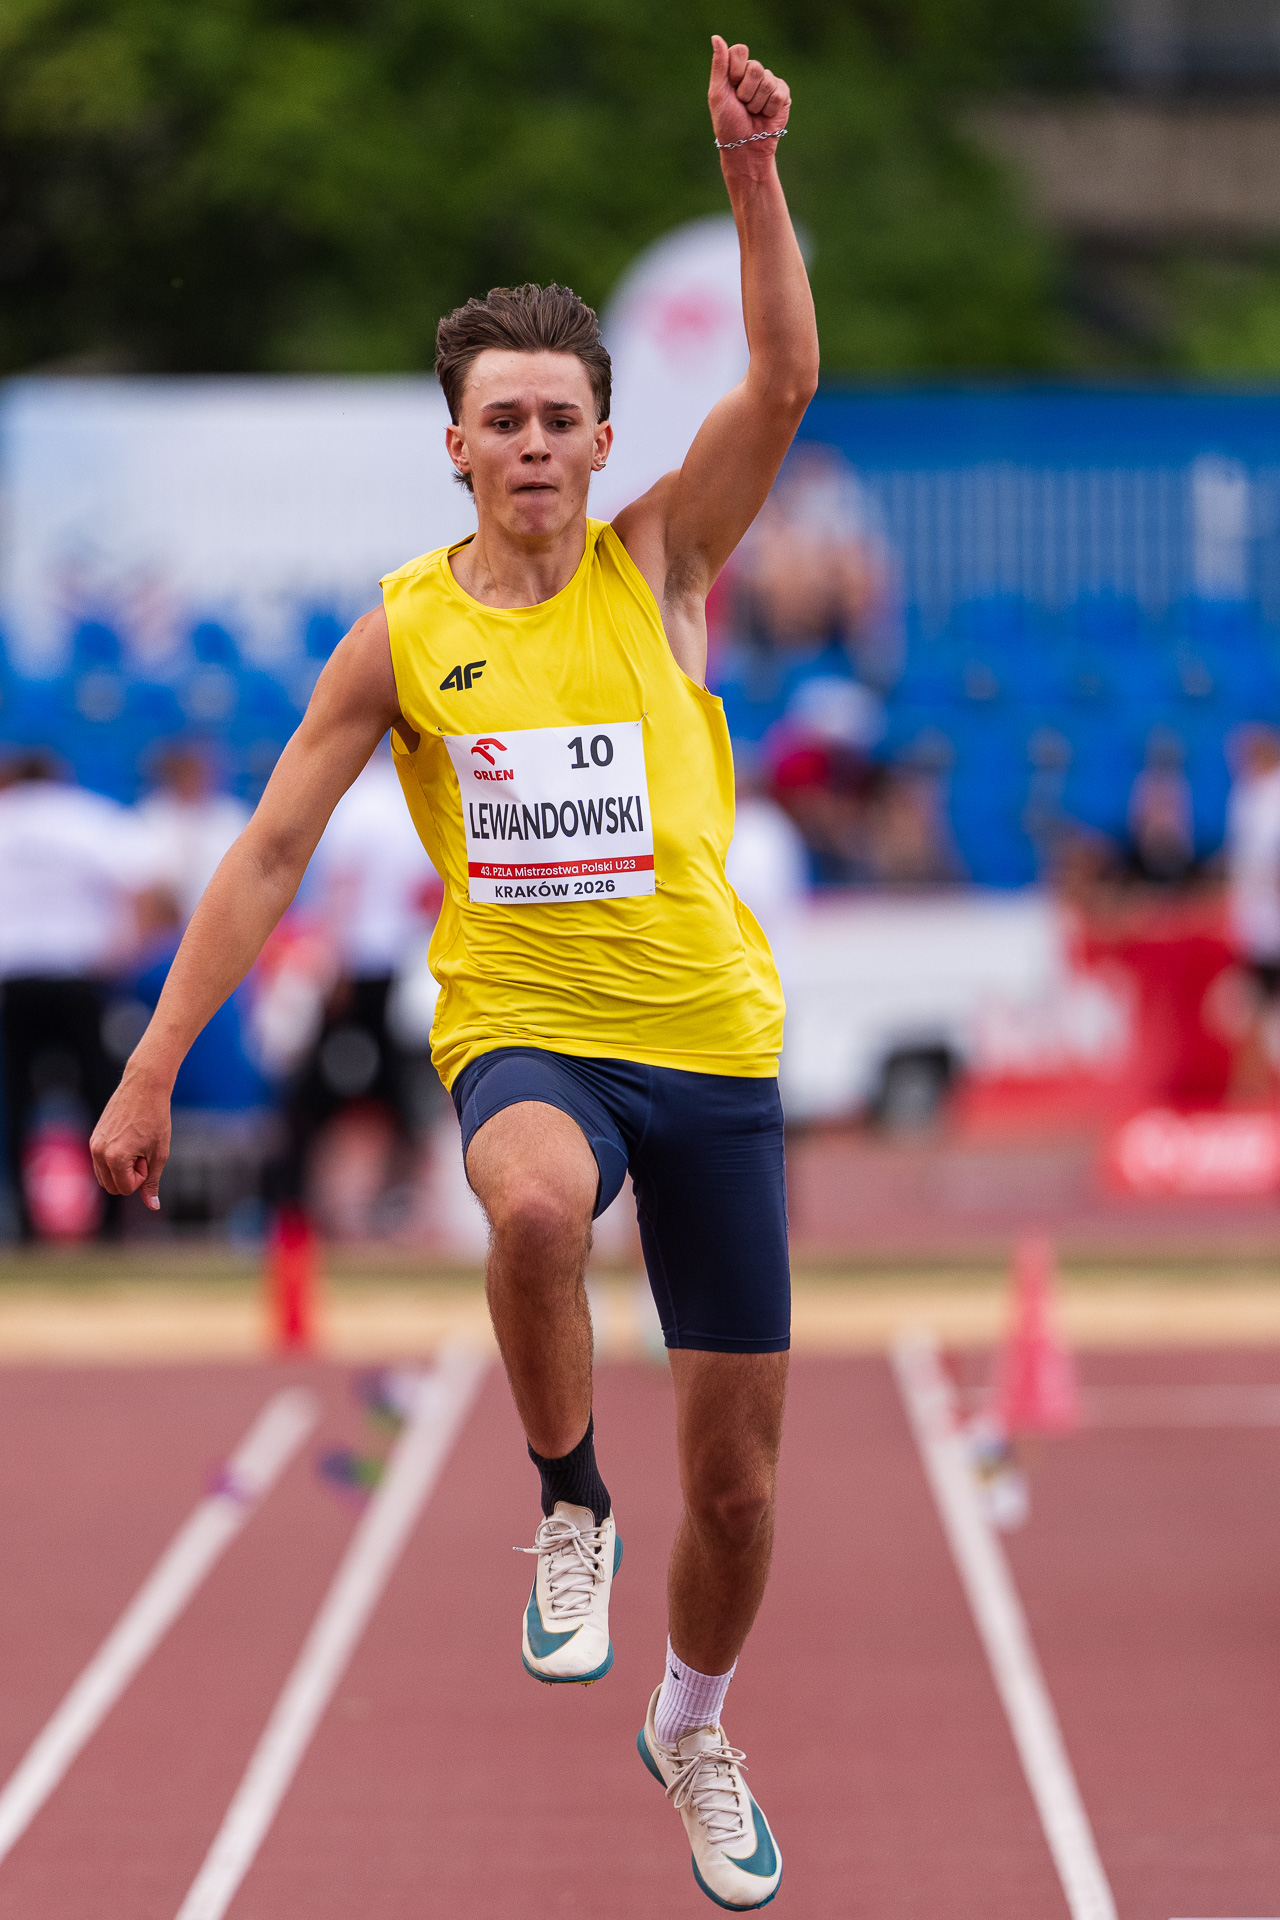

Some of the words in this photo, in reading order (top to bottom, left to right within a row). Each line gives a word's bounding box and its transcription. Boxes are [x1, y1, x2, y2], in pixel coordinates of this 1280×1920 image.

[440, 660, 487, 691] 4F
[567, 735, 614, 769] 10
[473, 769, 514, 781] ORLEN
[469, 796, 644, 840] LEWANDOWSKI
[480, 866, 492, 876] 43.
[493, 866, 512, 877] PZLA
[514, 864, 579, 877] Mistrzostwa
[581, 861, 613, 873] Polski
[615, 860, 636, 870] U23
[495, 881, 569, 898] KRAKÓW
[573, 880, 616, 895] 2026
